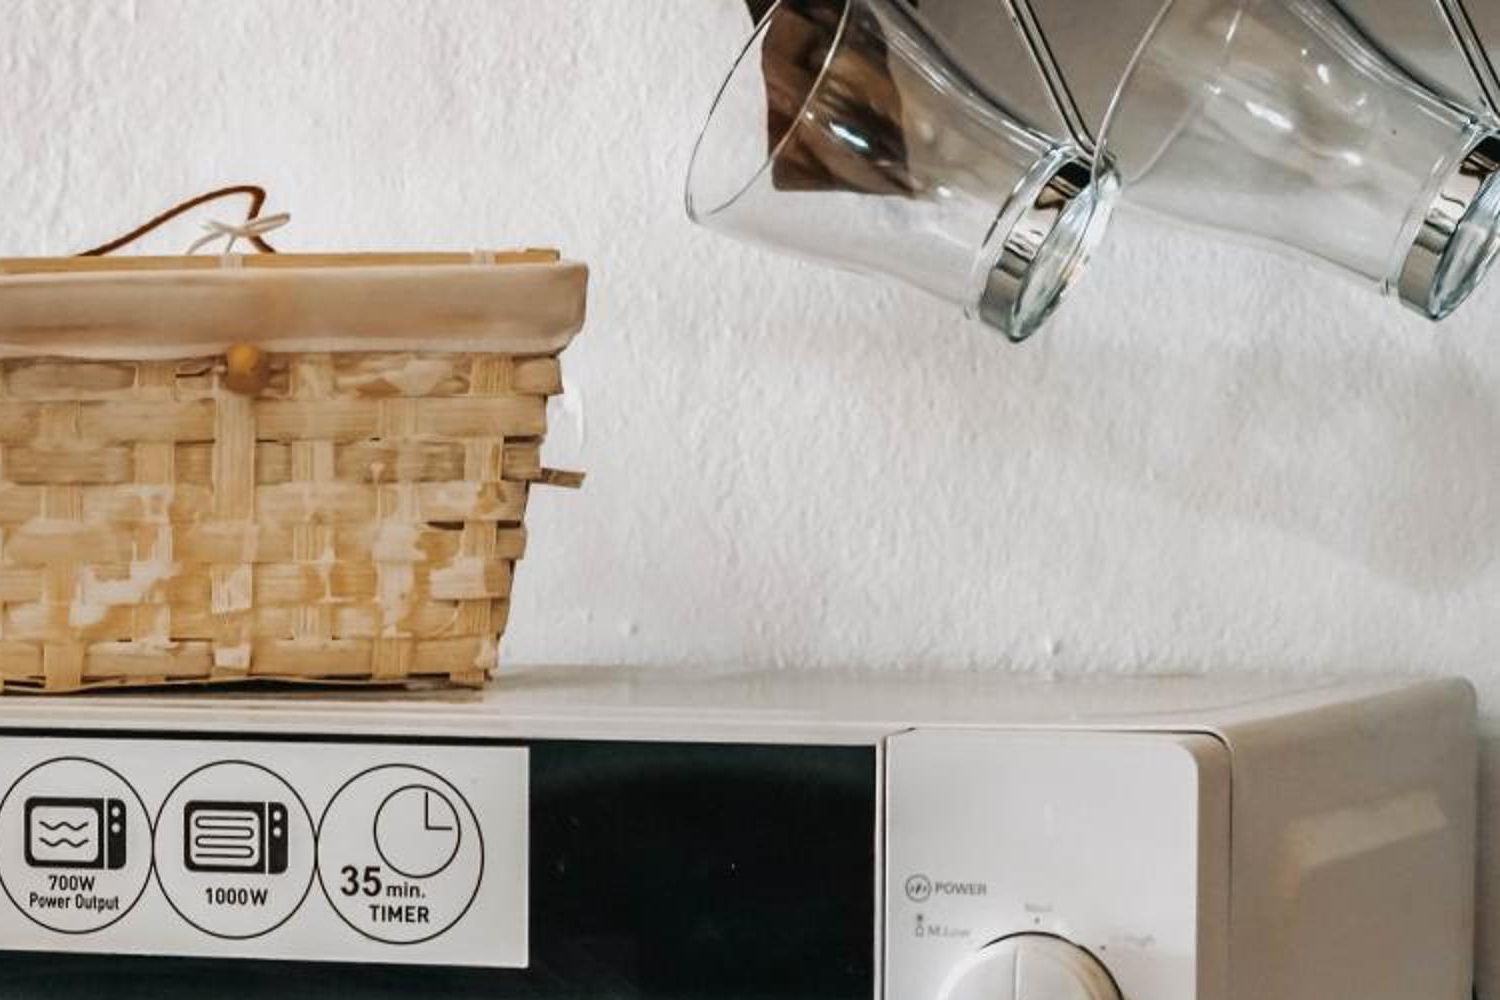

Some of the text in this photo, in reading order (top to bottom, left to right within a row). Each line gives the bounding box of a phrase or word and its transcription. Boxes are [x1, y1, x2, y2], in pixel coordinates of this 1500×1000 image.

[48, 875, 95, 891] 700W
[341, 865, 426, 898] 35 min.
[934, 882, 987, 896] POWER
[29, 892, 119, 914] Power Output
[205, 887, 268, 905] 1000W
[368, 904, 430, 923] TIMER
